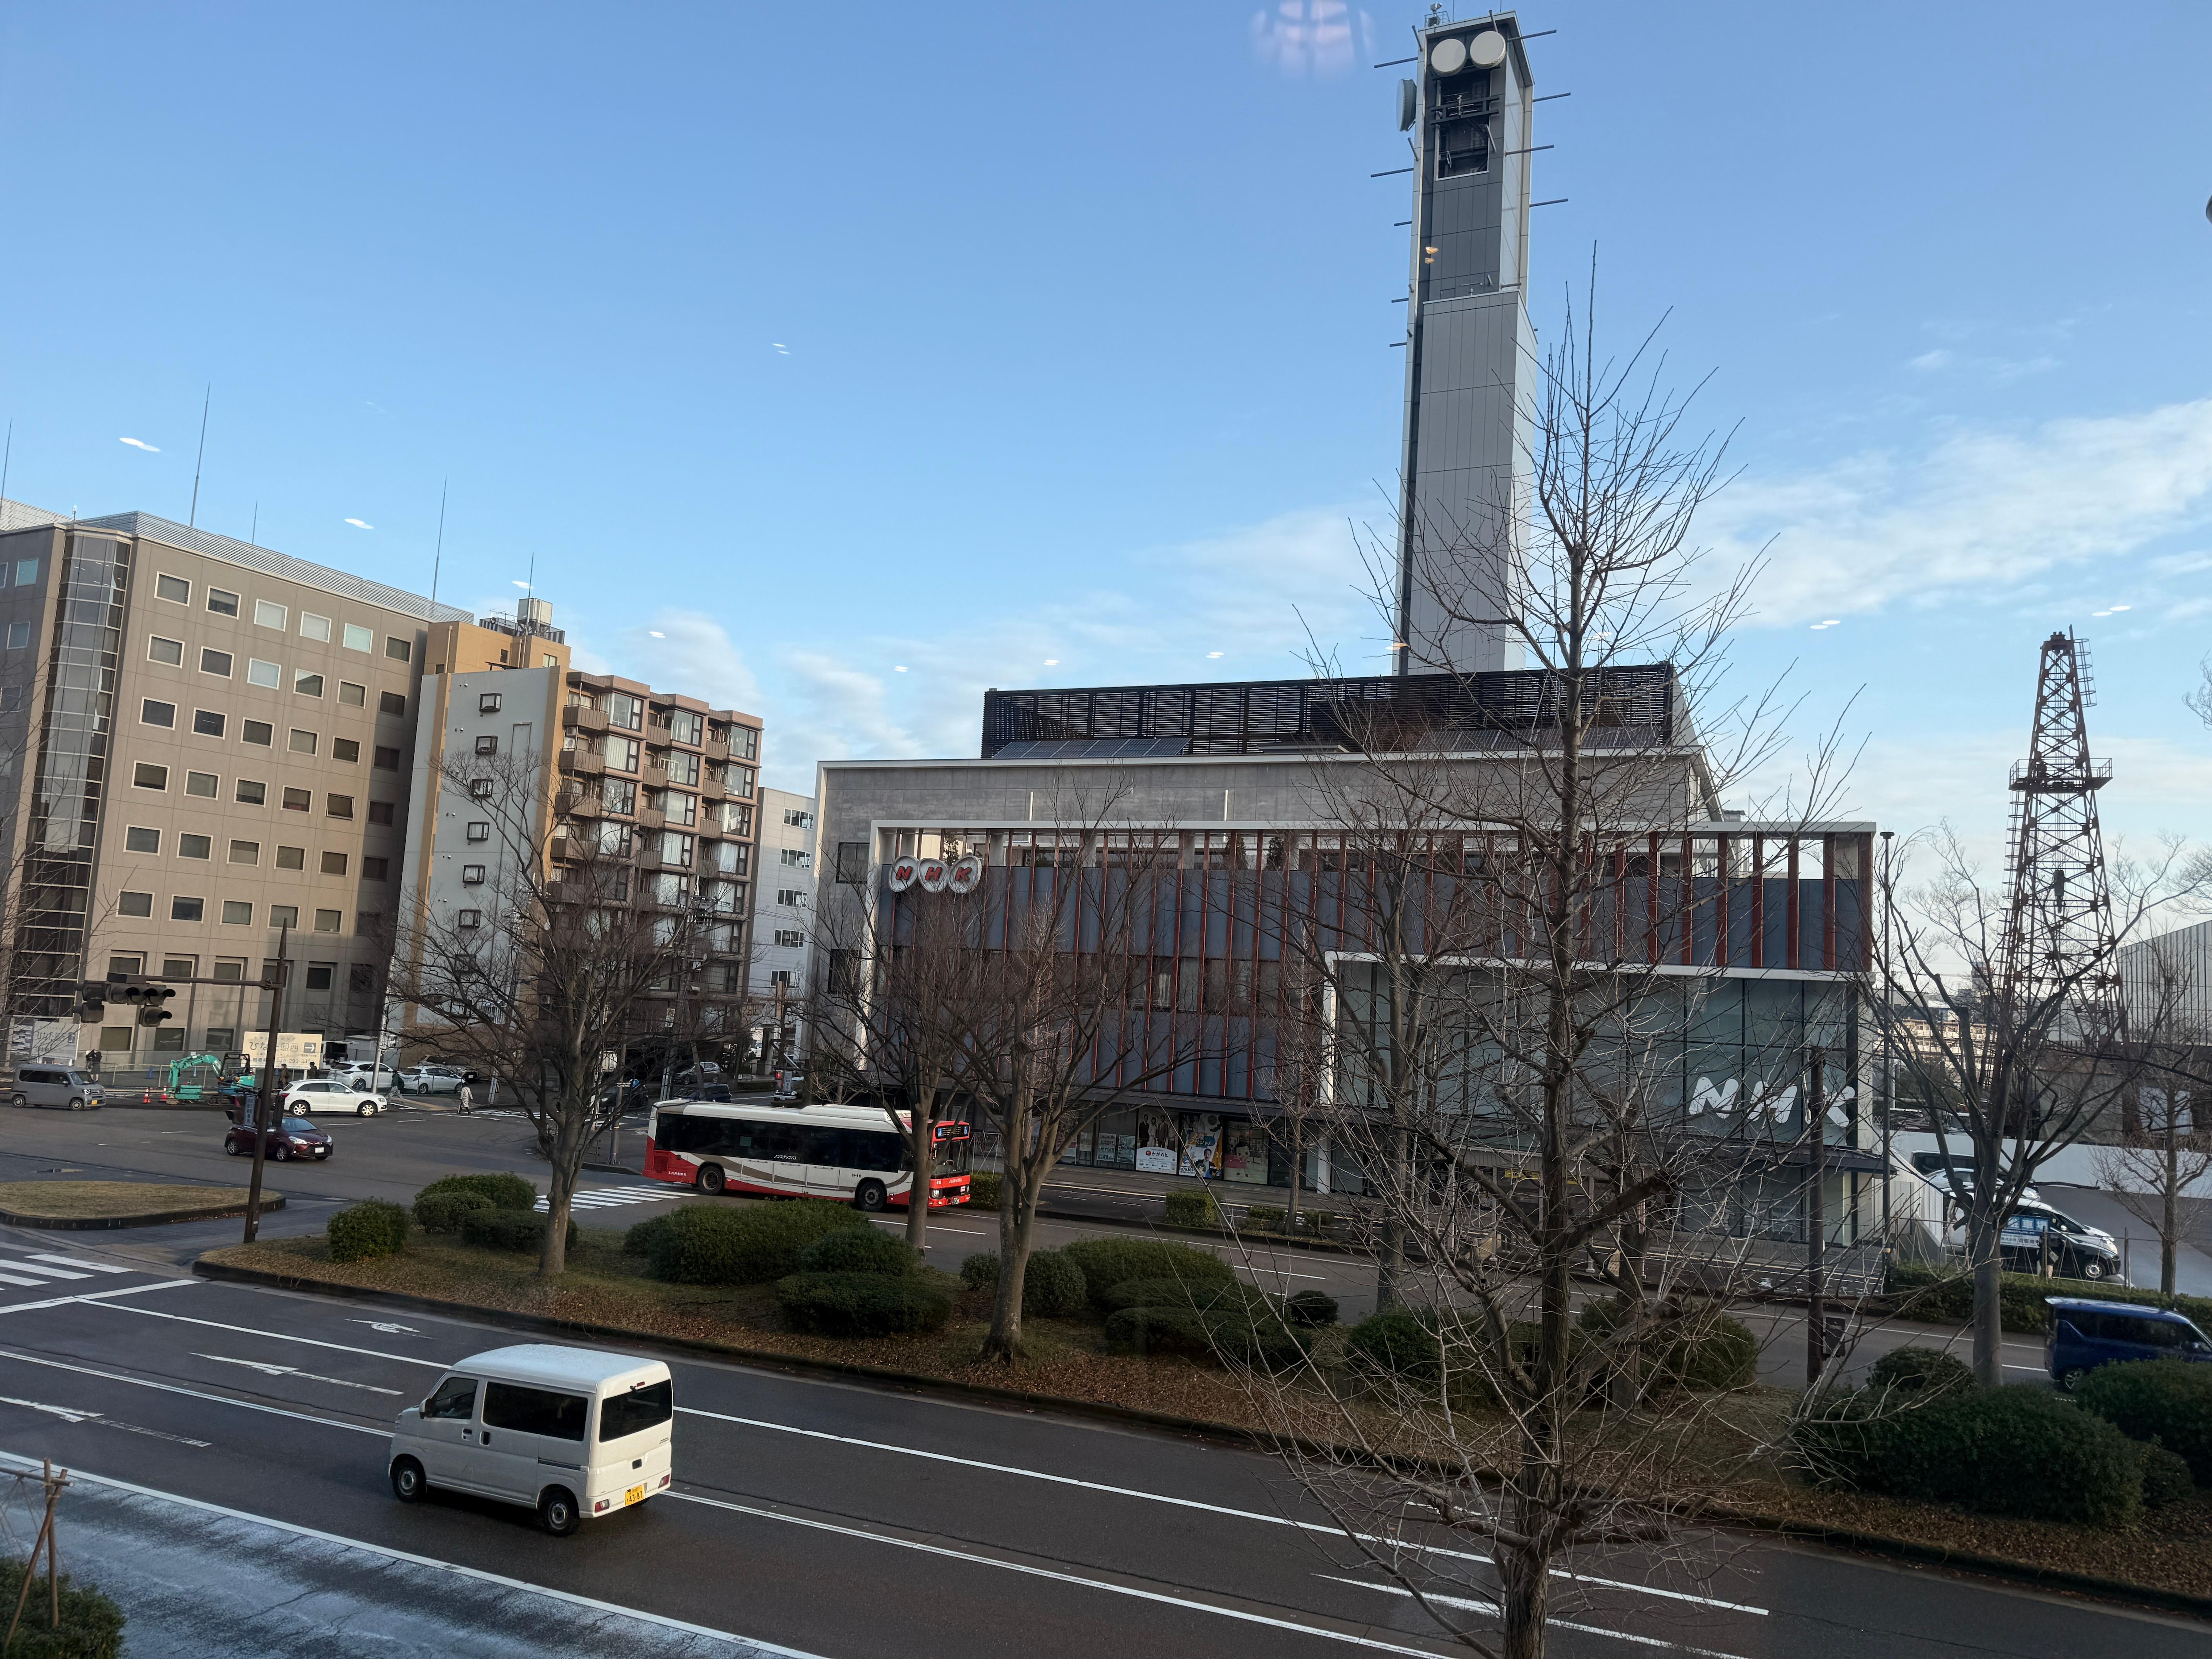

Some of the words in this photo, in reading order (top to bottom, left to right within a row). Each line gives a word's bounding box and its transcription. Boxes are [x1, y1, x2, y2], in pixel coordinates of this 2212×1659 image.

[895, 866, 972, 881] NHK
[249, 1042, 299, 1052] ひな駅西
[1689, 1077, 1857, 1128] NHK
